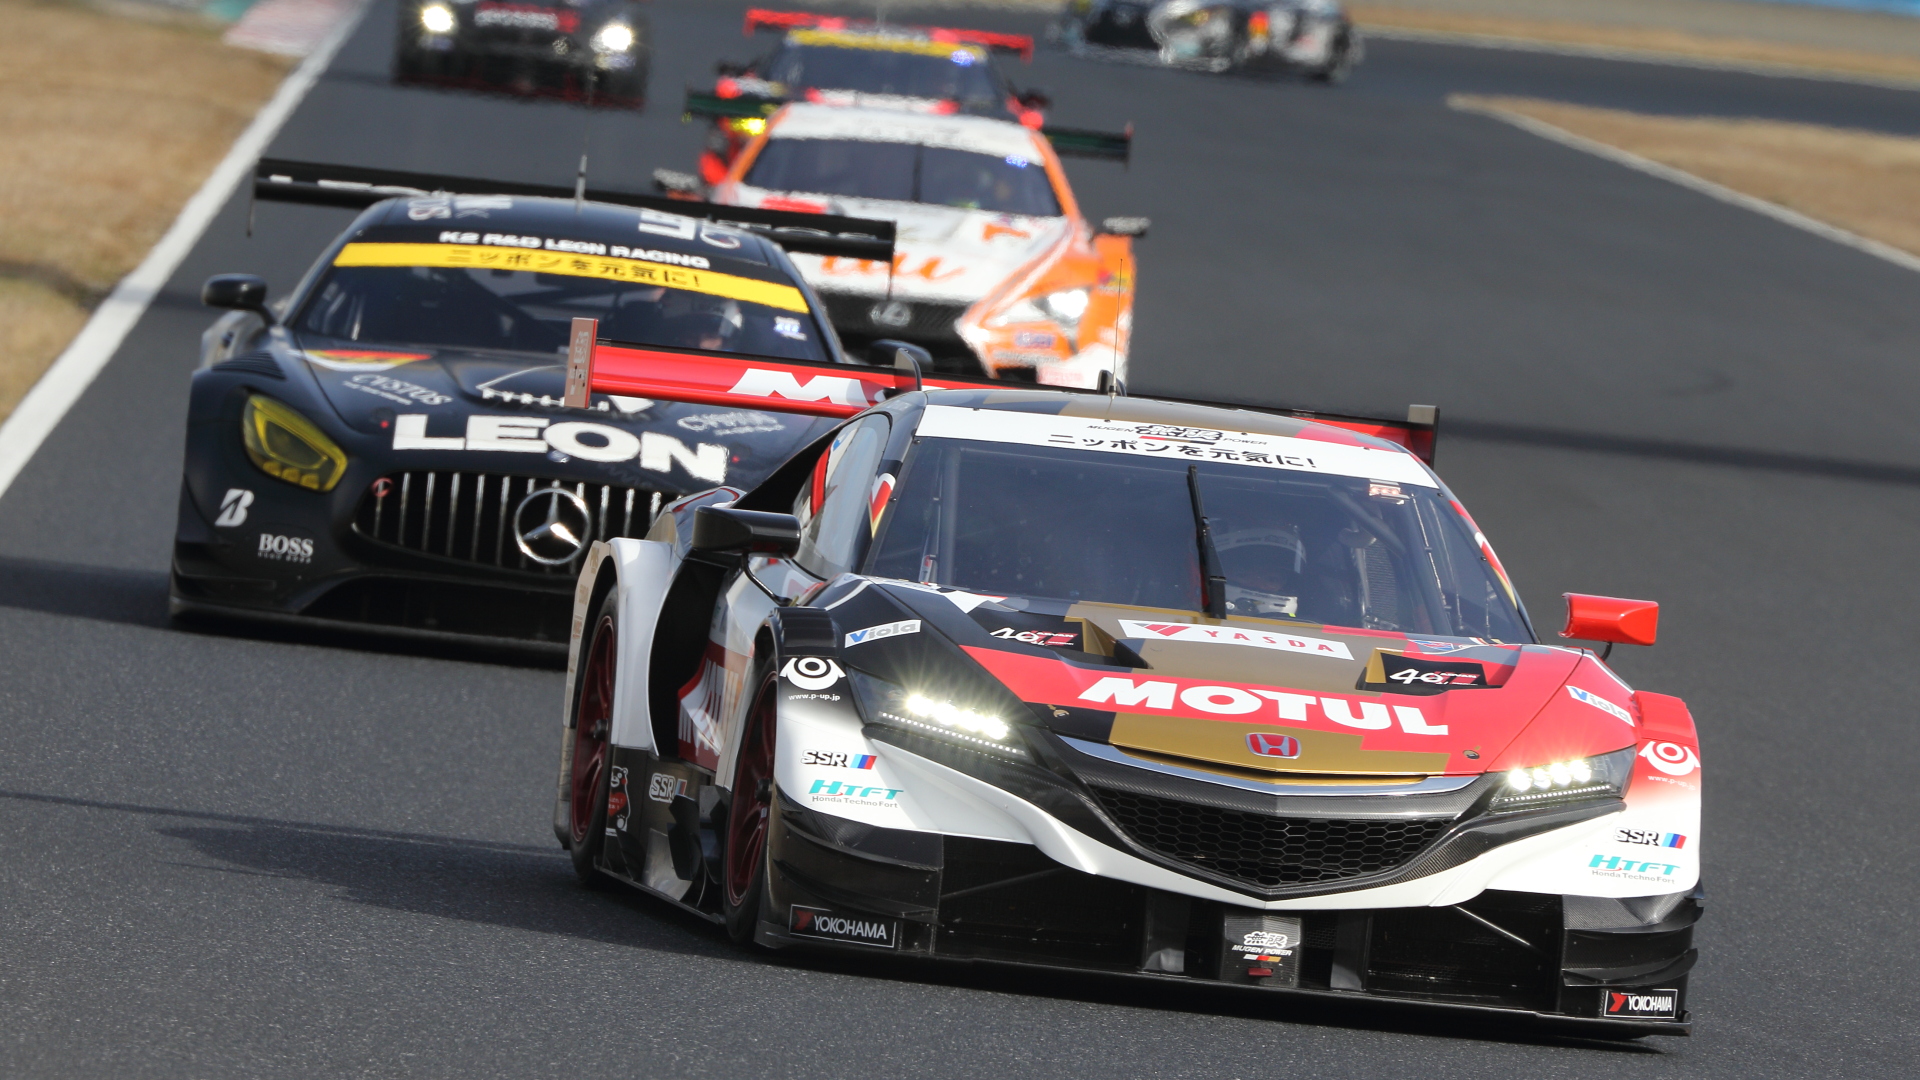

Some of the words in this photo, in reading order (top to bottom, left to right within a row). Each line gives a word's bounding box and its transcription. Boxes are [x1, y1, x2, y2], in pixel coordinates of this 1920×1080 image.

[439, 231, 480, 245] K2
[545, 237, 607, 256] LEON
[610, 246, 711, 270] RACING
[392, 413, 729, 485] LEON
[1222, 436, 1268, 446] POWER
[259, 533, 314, 557] BOSS
[850, 621, 917, 644] Viola
[1203, 629, 1336, 653] YASDA
[788, 693, 841, 702] www.p-up.jp
[1077, 676, 1449, 736] MOTUL
[1571, 686, 1630, 724] Viola
[801, 750, 848, 768] SSR
[649, 773, 676, 804] SSR
[812, 795, 842, 804] Honda
[1613, 827, 1660, 847] SSR
[1591, 869, 1621, 879] Honda
[814, 914, 888, 940] YOKOHAMA
[1231, 944, 1264, 954] MUGEN
[1263, 947, 1294, 956] POWER
[1627, 995, 1674, 1012] YOKOHAMA
